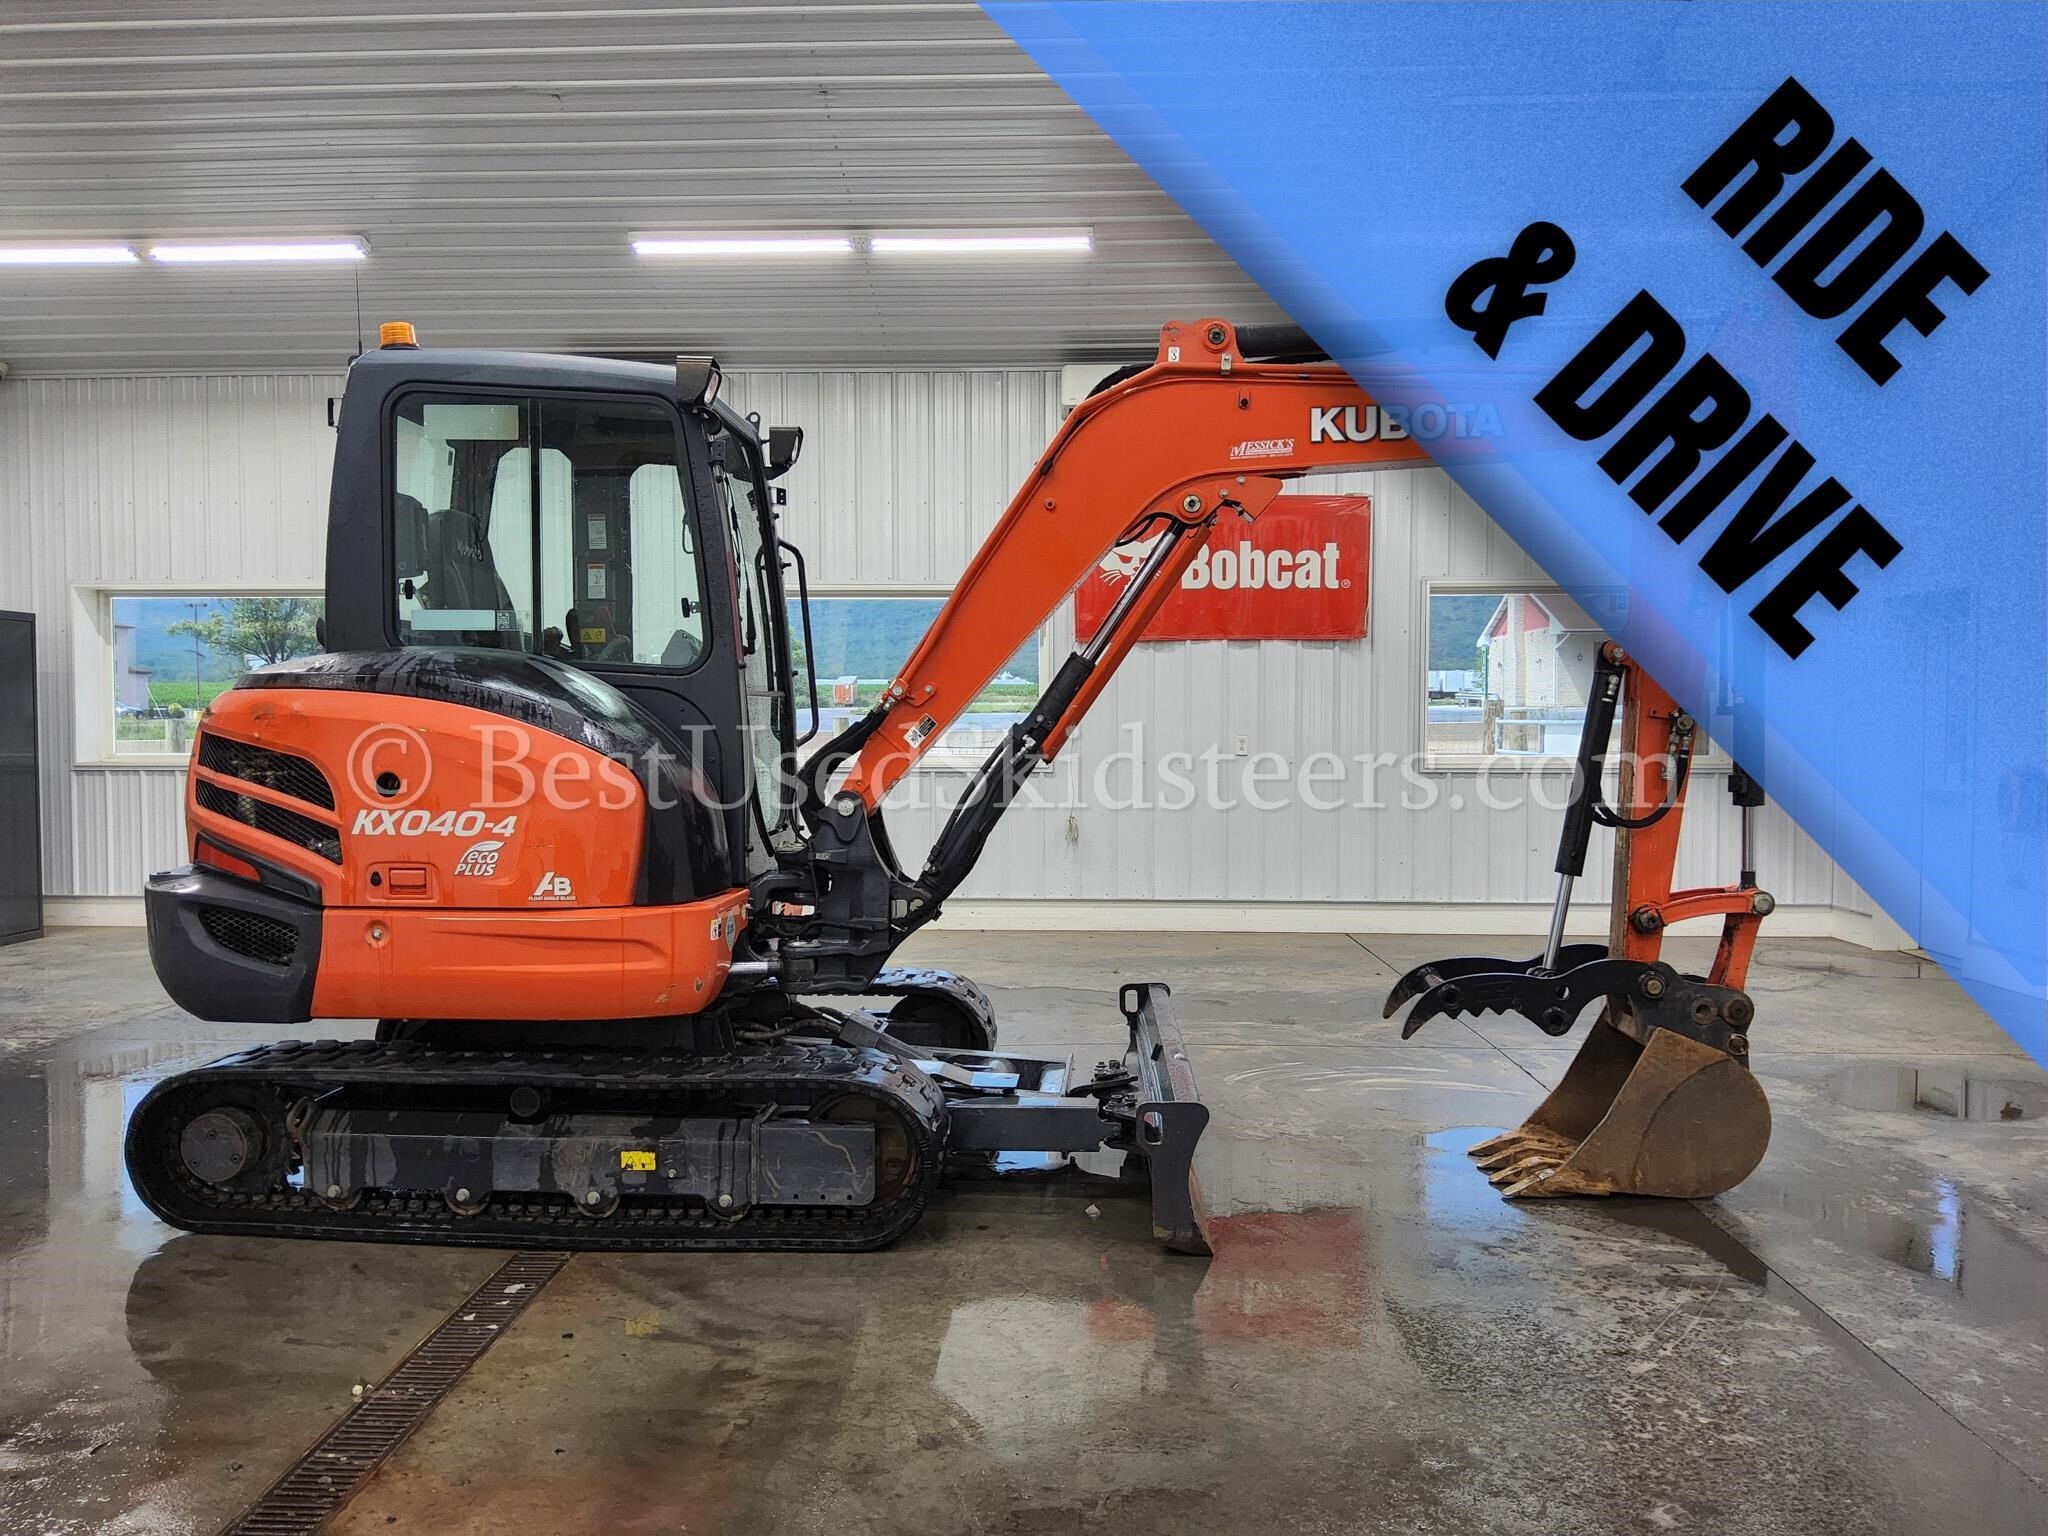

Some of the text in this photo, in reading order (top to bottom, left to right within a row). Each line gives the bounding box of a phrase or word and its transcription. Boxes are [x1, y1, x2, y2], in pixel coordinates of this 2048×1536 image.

[1310, 402, 1504, 443] KUBOTA
[351, 809, 517, 837] KX040-4
[467, 851, 499, 863] eco
[454, 862, 496, 876] PLUS
